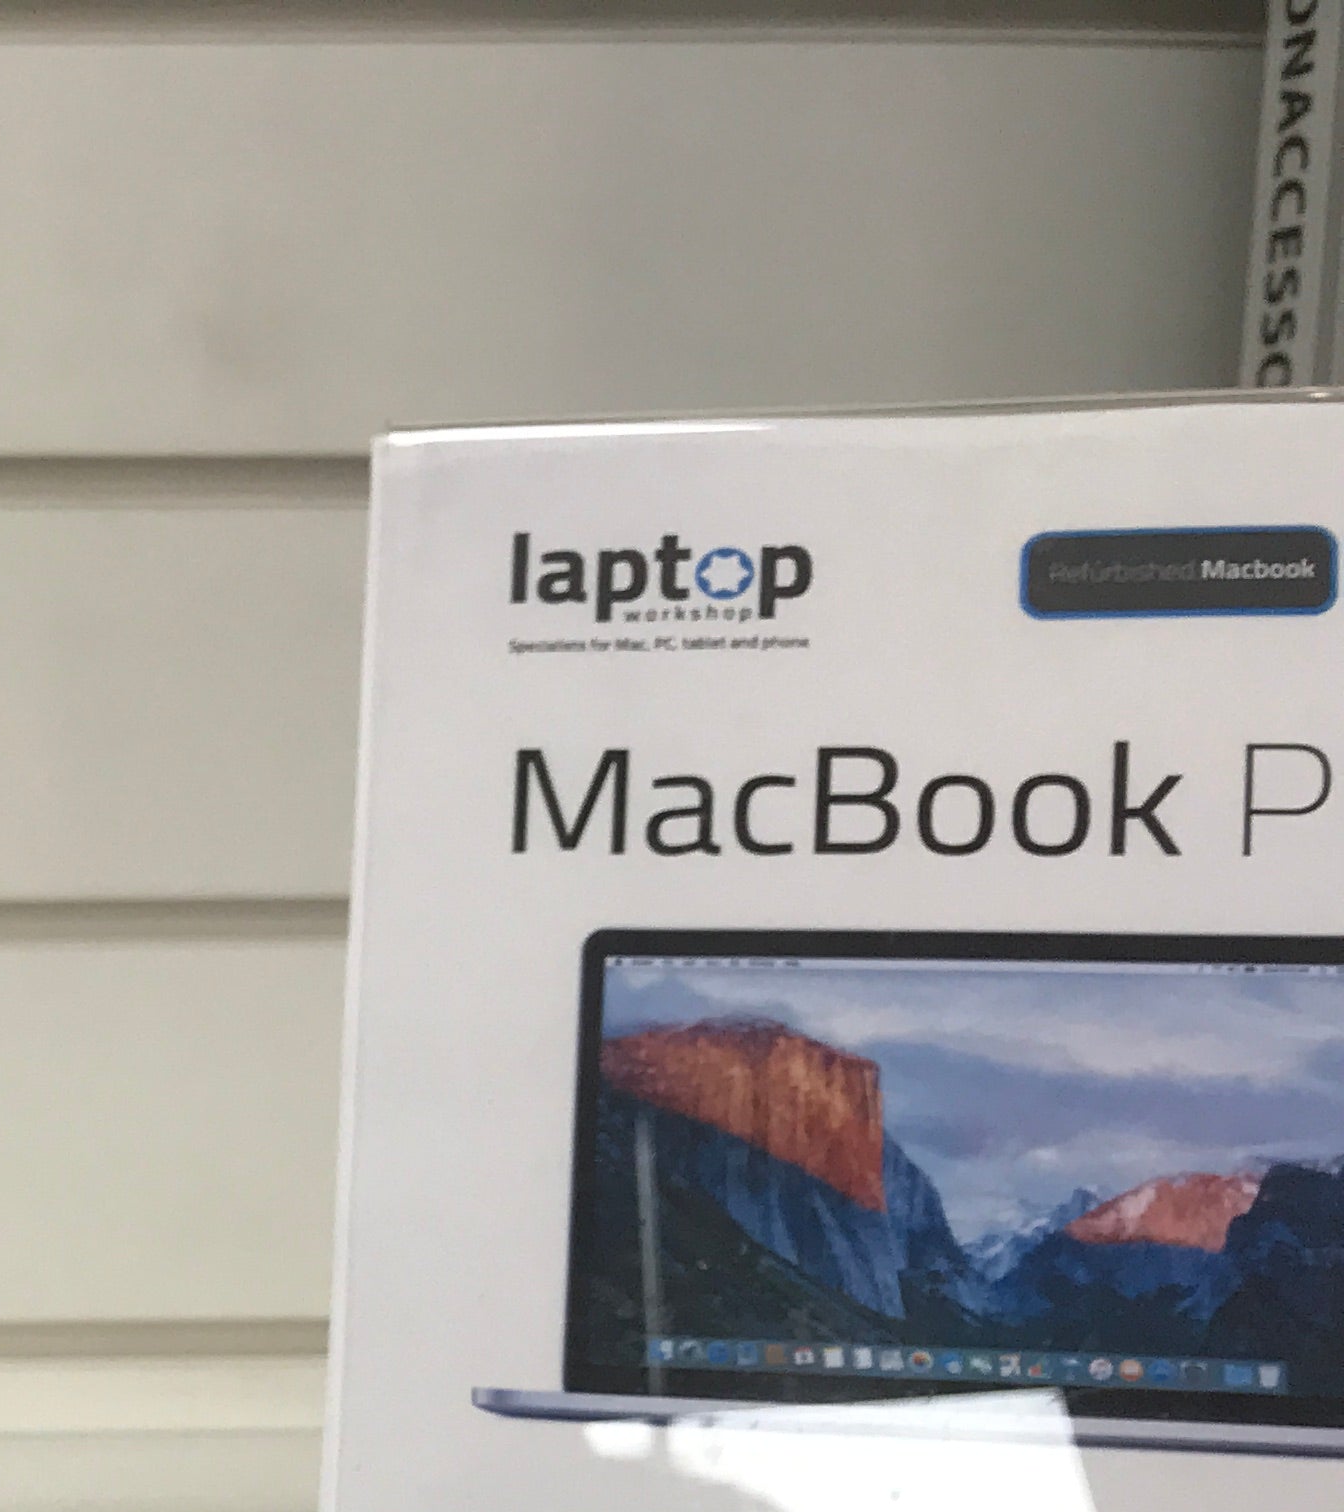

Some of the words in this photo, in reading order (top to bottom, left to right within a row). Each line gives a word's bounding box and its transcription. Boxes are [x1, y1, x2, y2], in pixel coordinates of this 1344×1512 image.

[509, 532, 814, 623] laptop
[1200, 557, 1316, 581] Macbook
[623, 605, 753, 624] workshop
[511, 741, 1184, 858] MacBook
[1241, 742, 1336, 858] P
